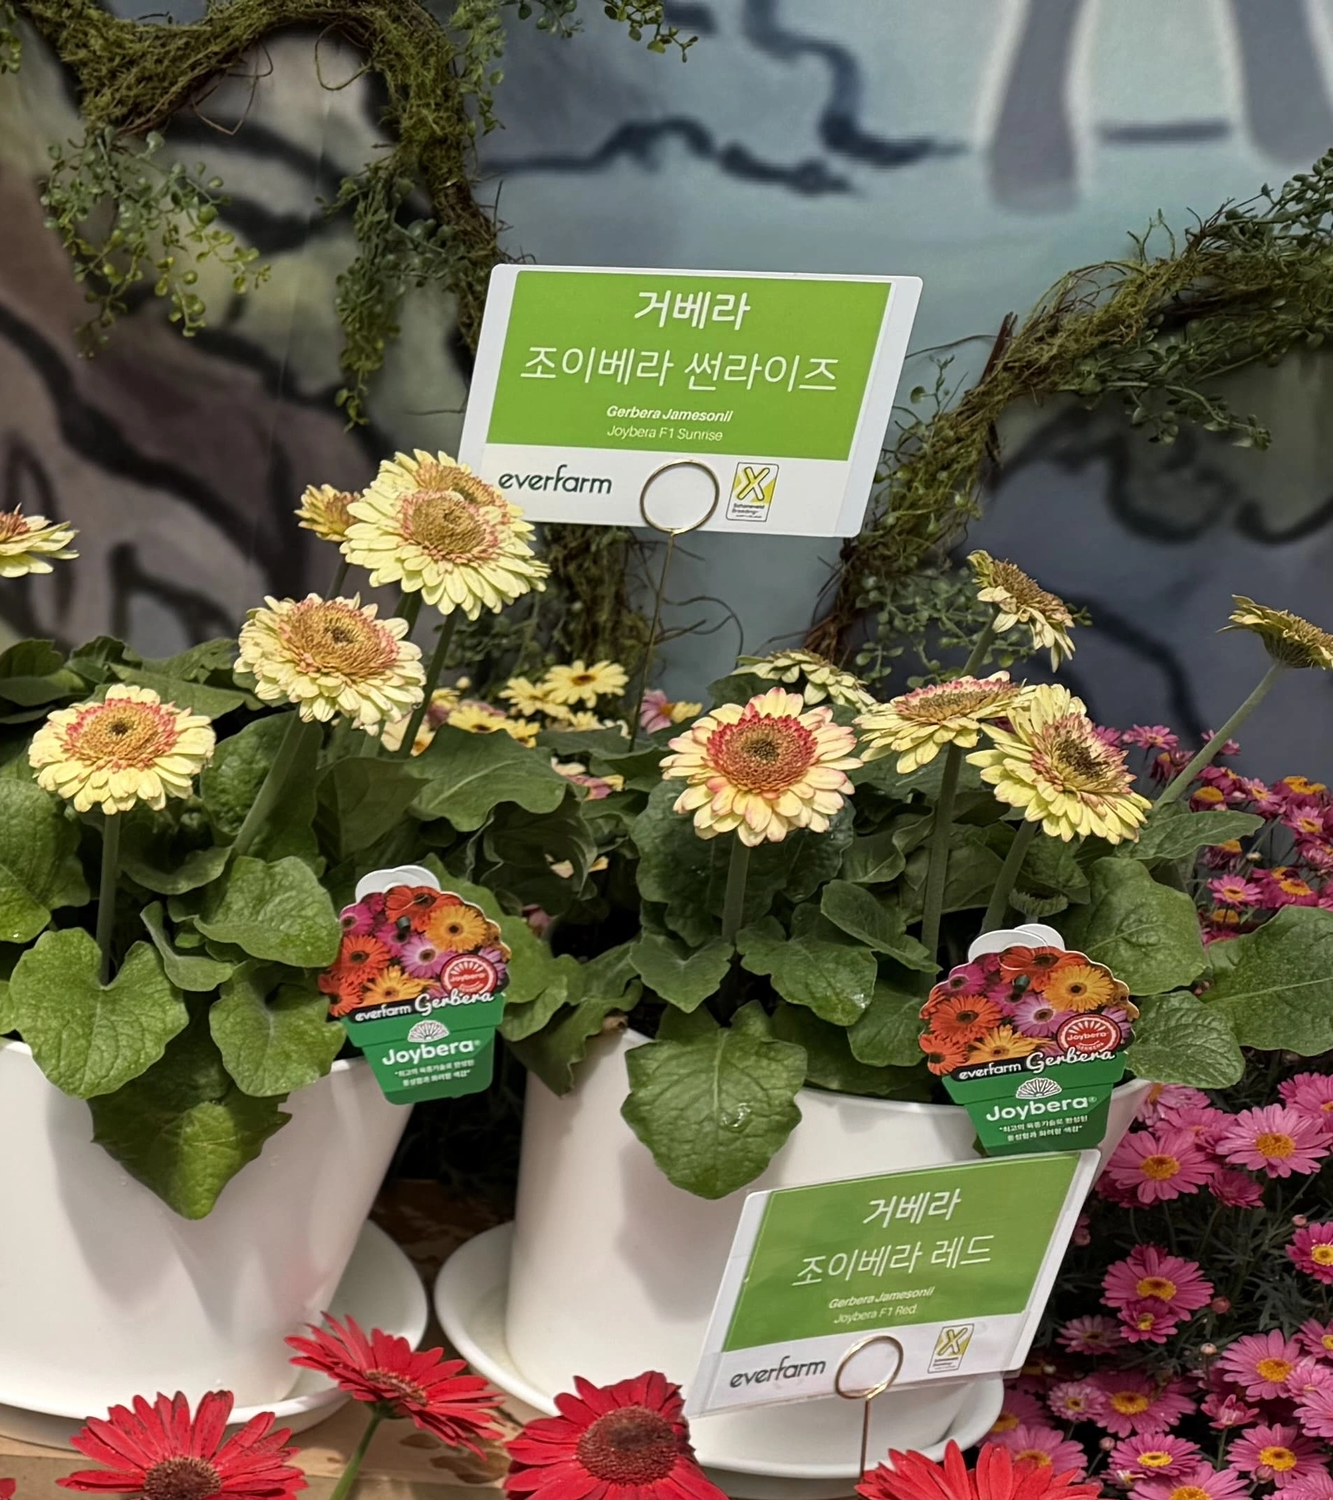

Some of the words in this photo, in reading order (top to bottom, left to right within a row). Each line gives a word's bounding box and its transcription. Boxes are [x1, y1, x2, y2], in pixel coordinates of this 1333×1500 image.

[634, 289, 751, 330] 거베라
[520, 346, 674, 387] 조이베라
[684, 352, 839, 392] 썬라이즈
[606, 405, 661, 420] Gerbera
[662, 407, 733, 423] Jamesonii
[607, 425, 656, 440] Joybera
[659, 427, 675, 439] F1
[676, 427, 723, 441] Sunrise
[498, 463, 612, 494] everfarm
[355, 1003, 412, 1022] everfarm
[414, 988, 494, 1016] Gerbera
[959, 1062, 1021, 1080] everfarm
[1026, 1047, 1115, 1075] Gerbera
[862, 1188, 962, 1229] 거베라
[792, 1241, 922, 1288] 조이베라
[930, 1234, 995, 1270] 레드
[829, 1292, 876, 1310] Gerbera
[874, 1286, 935, 1304] Jamesonii
[834, 1310, 878, 1325] Joybera
[879, 1307, 893, 1318] F1
[894, 1304, 917, 1317] Red
[729, 1355, 827, 1389] everfarm
